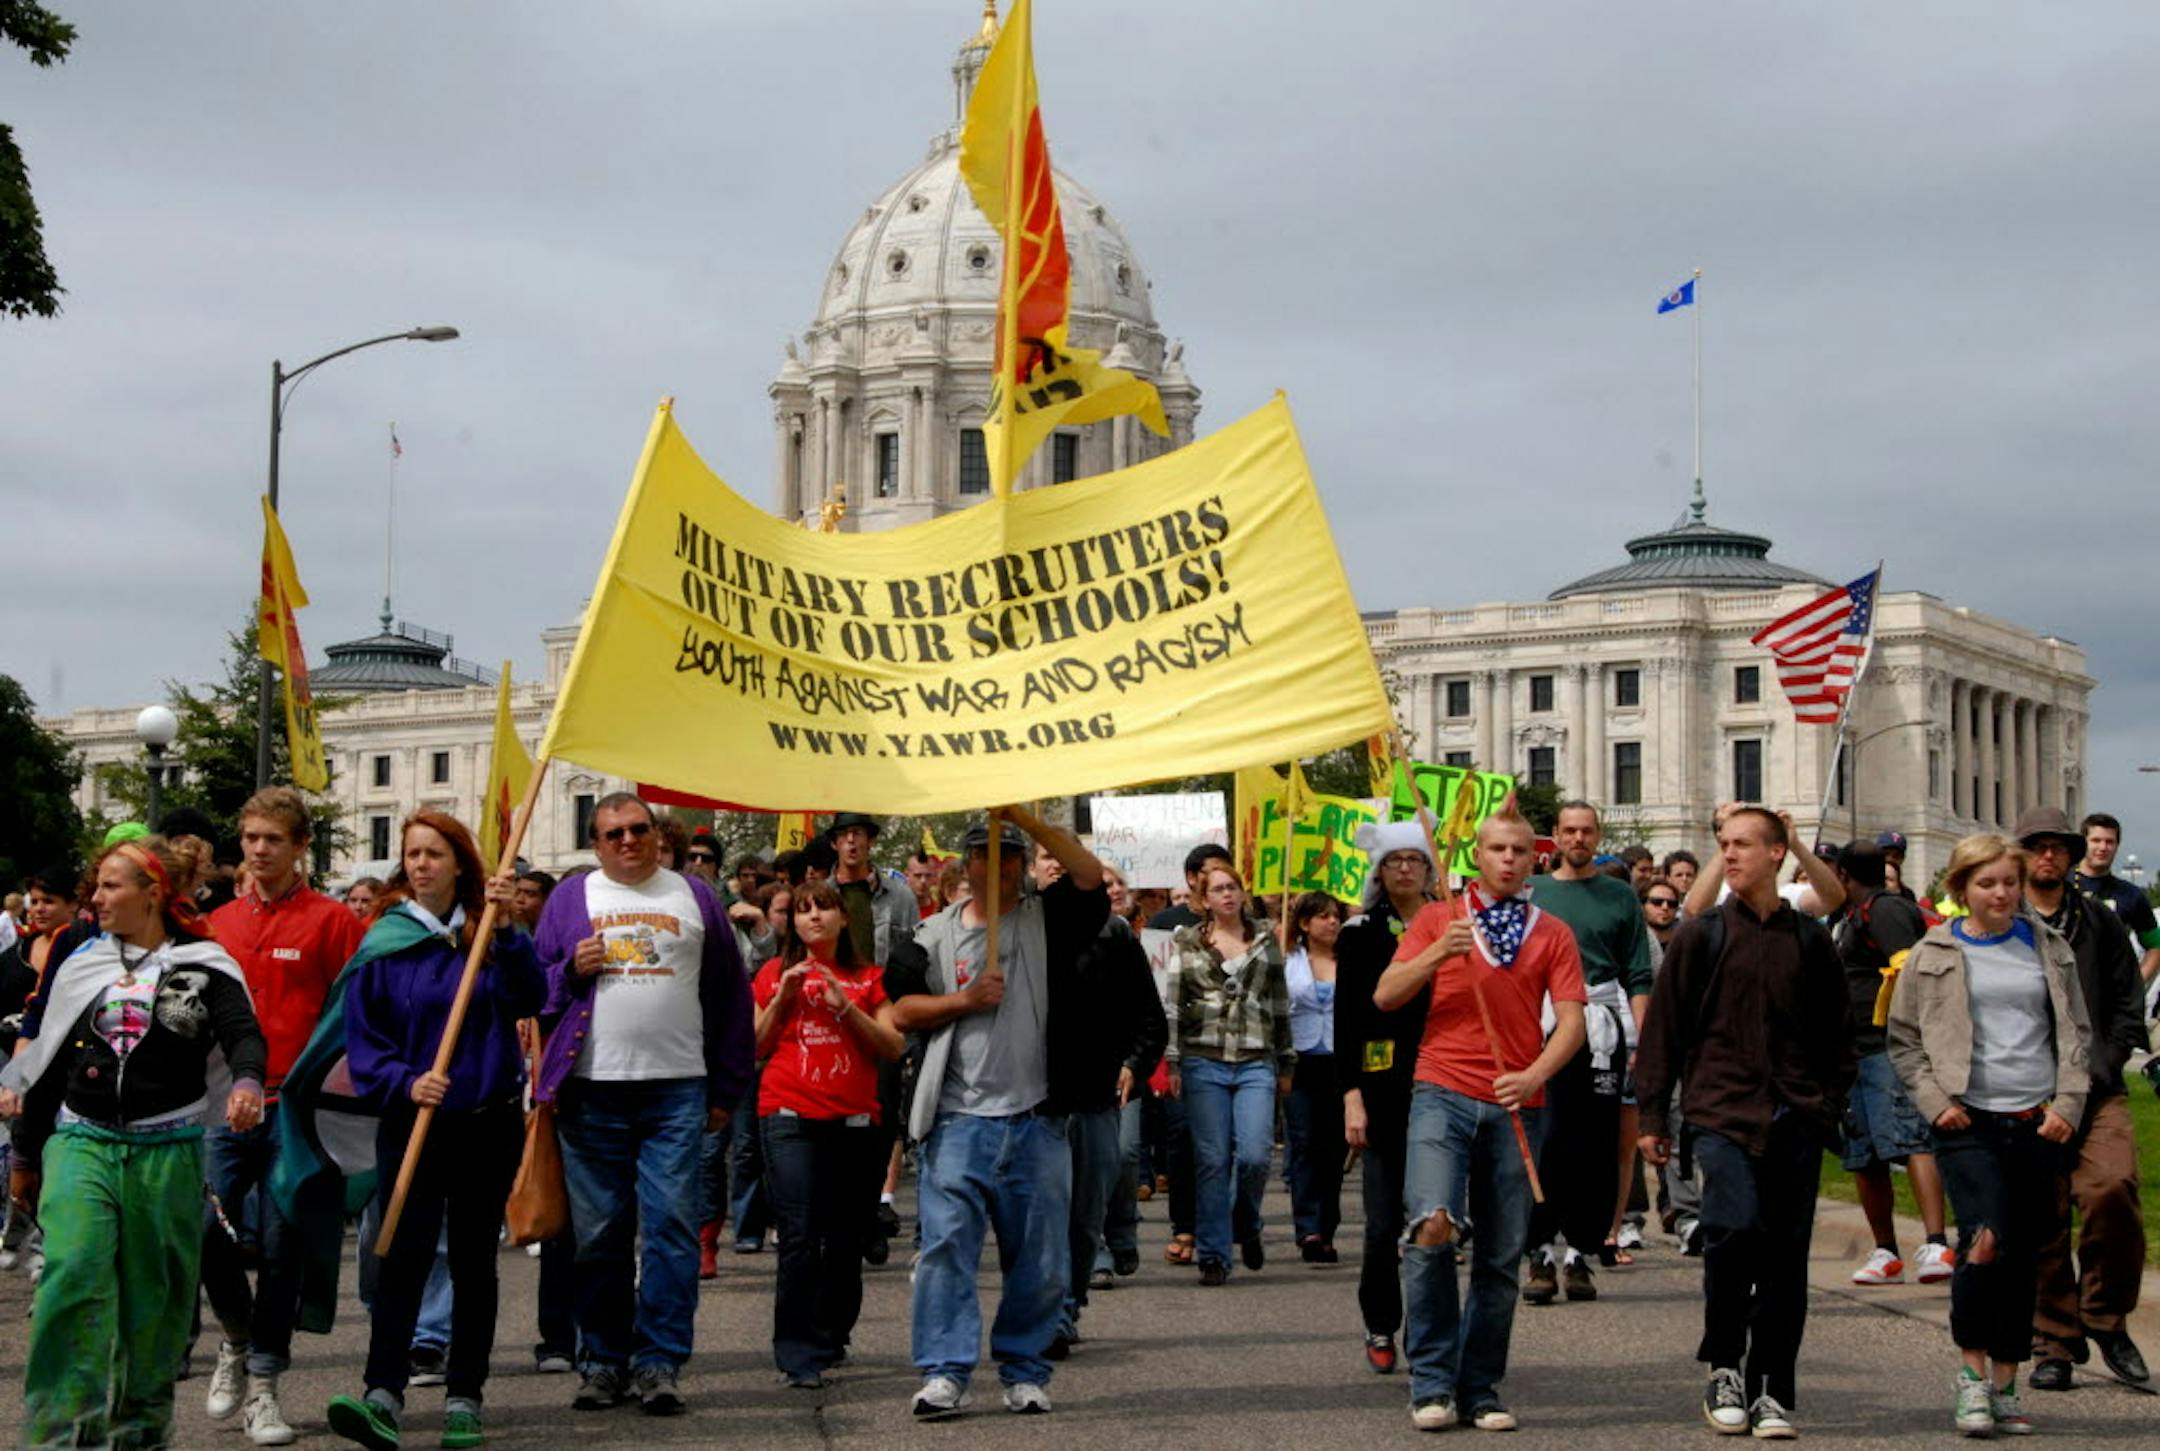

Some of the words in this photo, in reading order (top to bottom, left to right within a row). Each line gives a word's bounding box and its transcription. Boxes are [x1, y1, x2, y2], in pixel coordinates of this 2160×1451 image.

[675, 512, 868, 618] MILITARY
[885, 495, 1230, 619] RECRUITERS
[681, 569, 757, 638] OUT
[769, 606, 825, 654] OF
[840, 620, 954, 663] OUR
[966, 549, 1230, 659] SCHOOLS!
[675, 624, 766, 699] YOUTH
[915, 676, 1009, 717] WAR
[1021, 656, 1099, 709] AND
[767, 711, 1117, 757] WWW.YAWR.ORG
